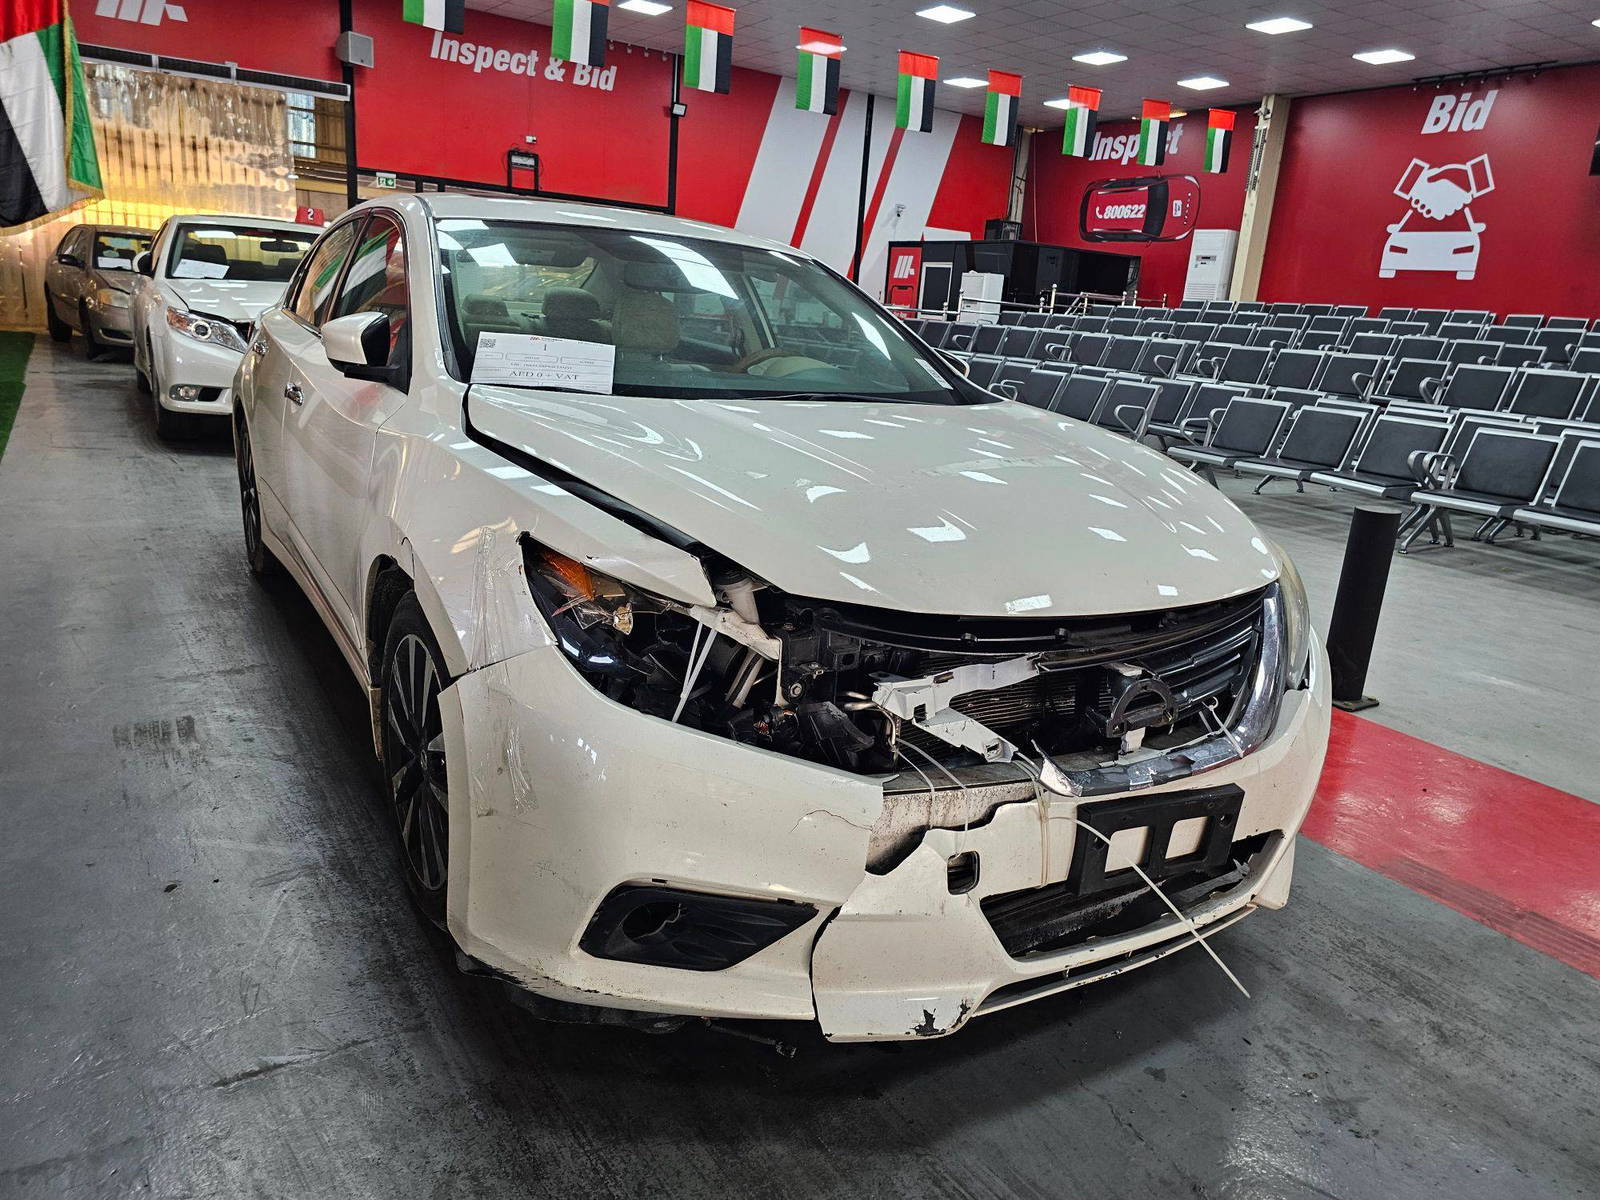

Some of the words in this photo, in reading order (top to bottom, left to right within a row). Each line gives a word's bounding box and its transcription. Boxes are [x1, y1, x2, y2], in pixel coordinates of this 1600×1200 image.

[429, 30, 539, 77] Inspect
[544, 56, 566, 82] &
[572, 63, 618, 91] Bid
[1420, 90, 1498, 134] Bid
[1089, 123, 1183, 165] Inspt
[307, 208, 314, 220] 2
[1103, 204, 1147, 219] 800622
